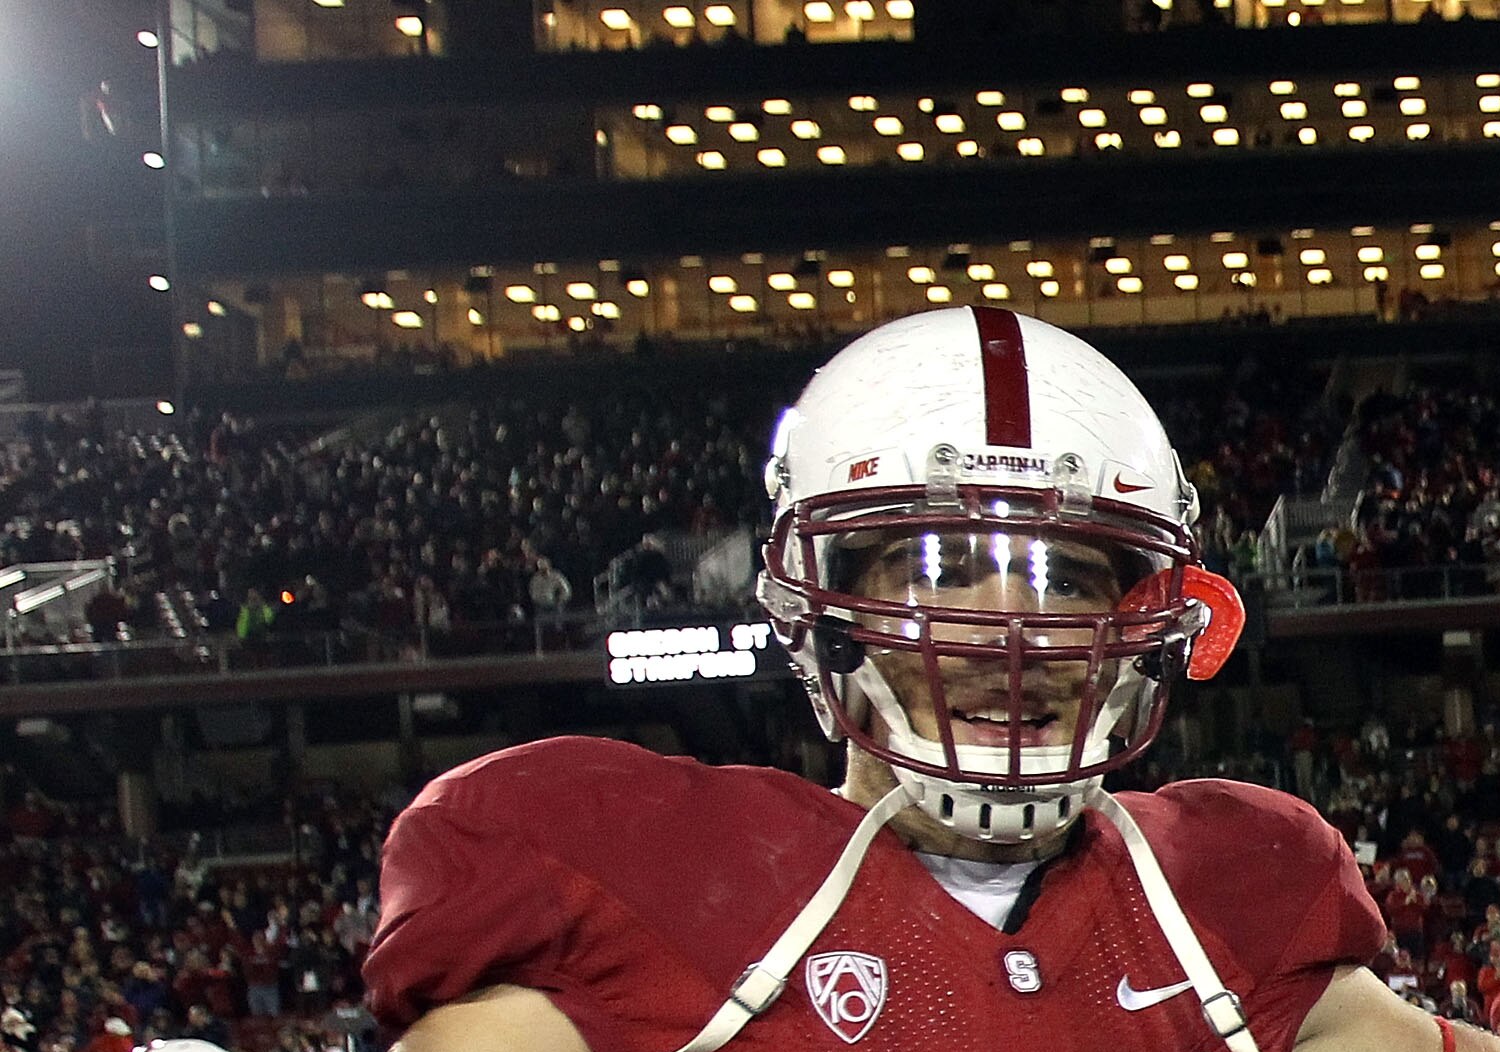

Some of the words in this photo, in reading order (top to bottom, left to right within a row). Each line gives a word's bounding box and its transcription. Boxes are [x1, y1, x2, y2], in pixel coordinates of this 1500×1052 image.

[848, 457, 880, 483] NIKE
[963, 453, 1051, 476] CARDINAL
[809, 955, 881, 1008] PAC
[1004, 950, 1042, 993] S
[830, 990, 873, 1024] 10
